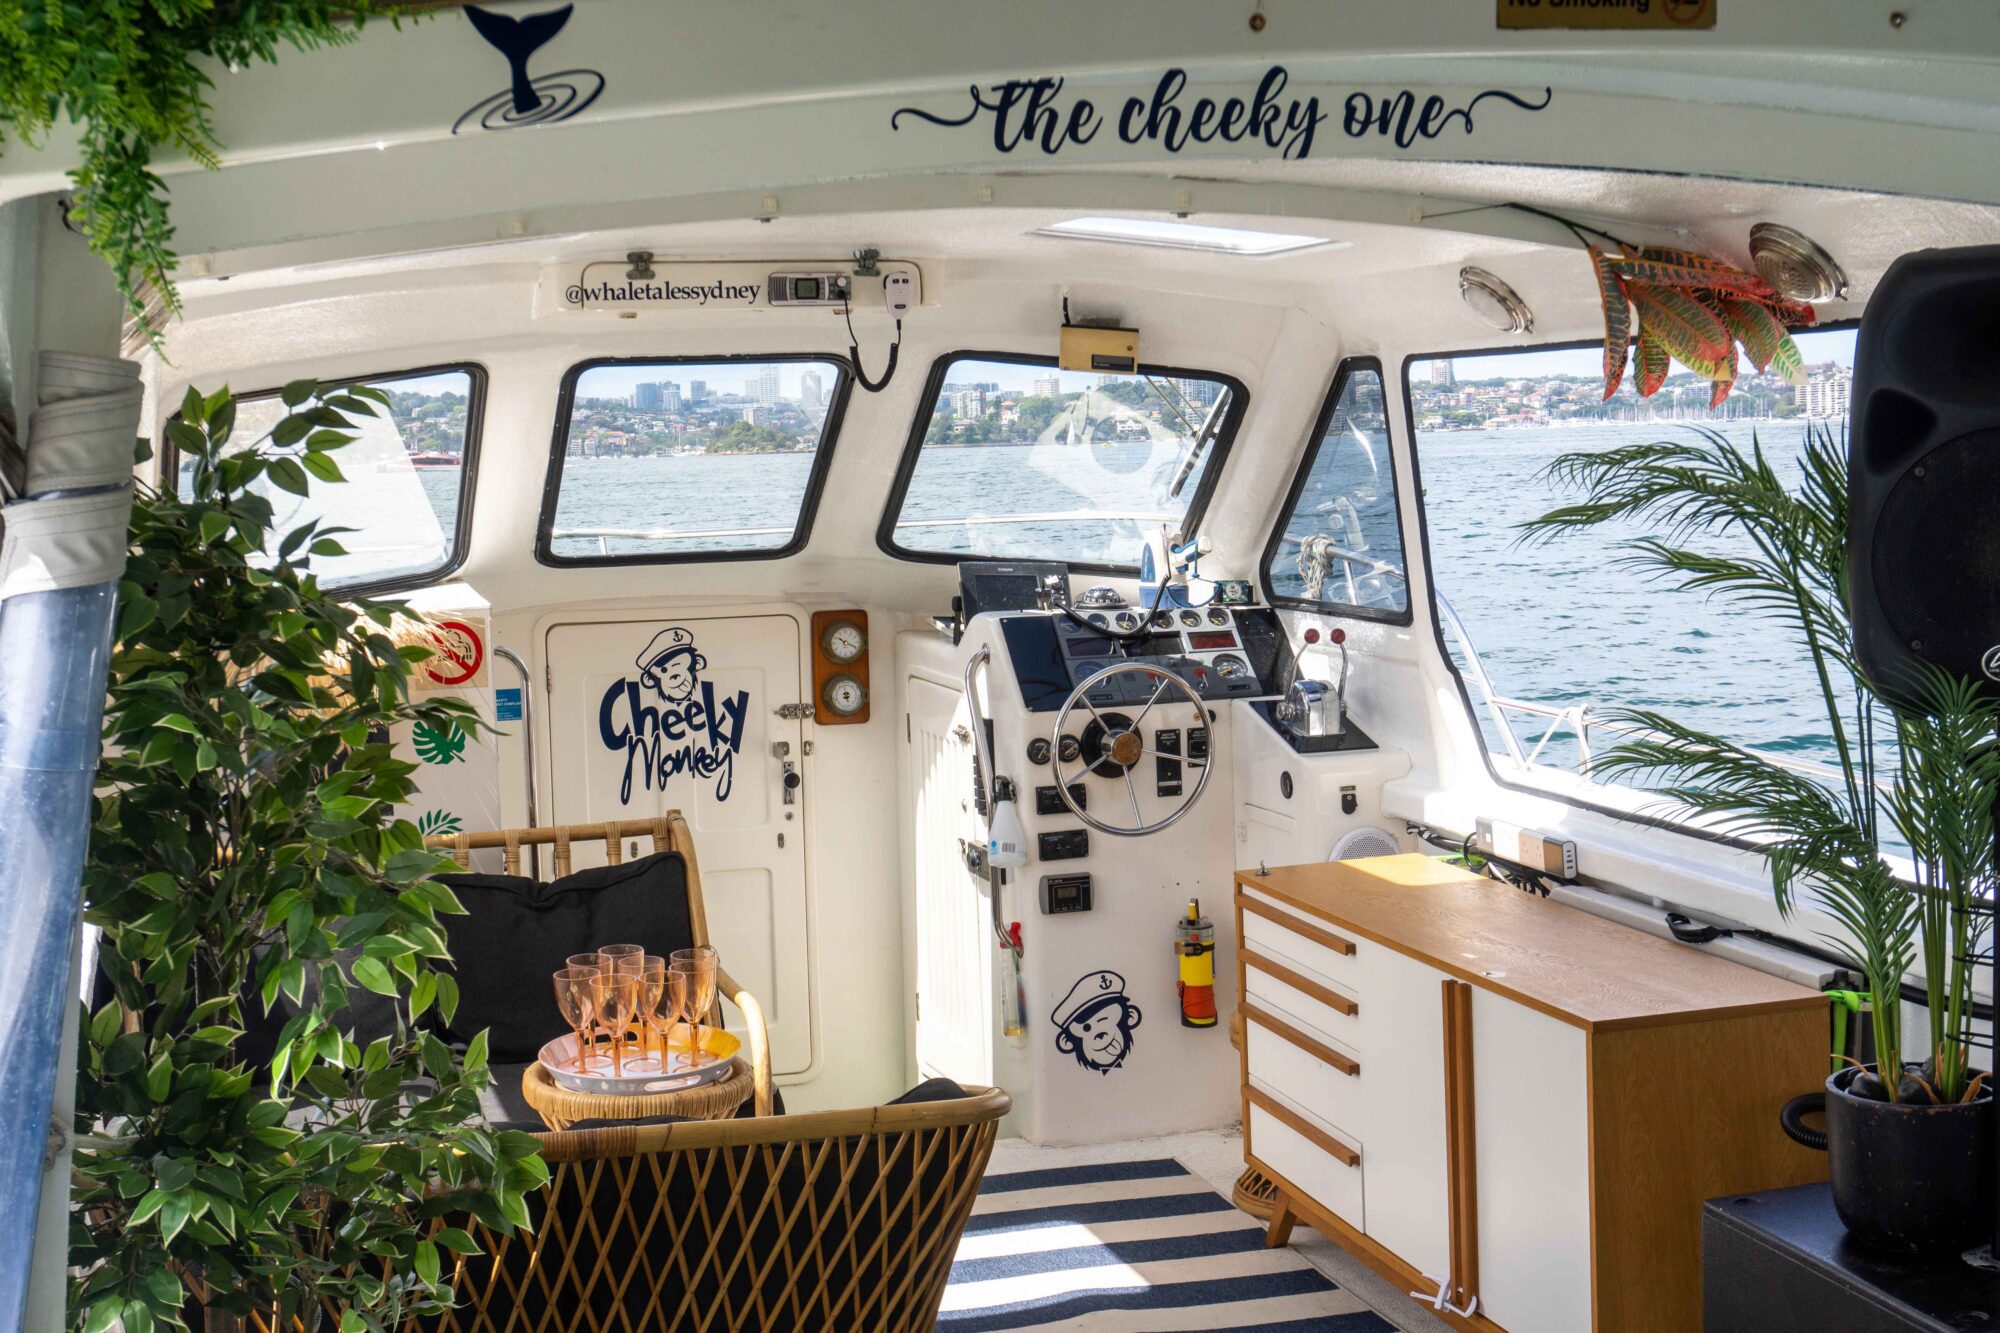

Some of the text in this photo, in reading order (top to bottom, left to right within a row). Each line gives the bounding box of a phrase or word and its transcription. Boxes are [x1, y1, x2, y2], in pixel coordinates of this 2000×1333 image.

[892, 64, 1552, 161] the cheeky one
[565, 280, 761, 306] @whaletalessydney
[598, 677, 750, 754] Cheeky
[620, 733, 733, 806] Monkey
